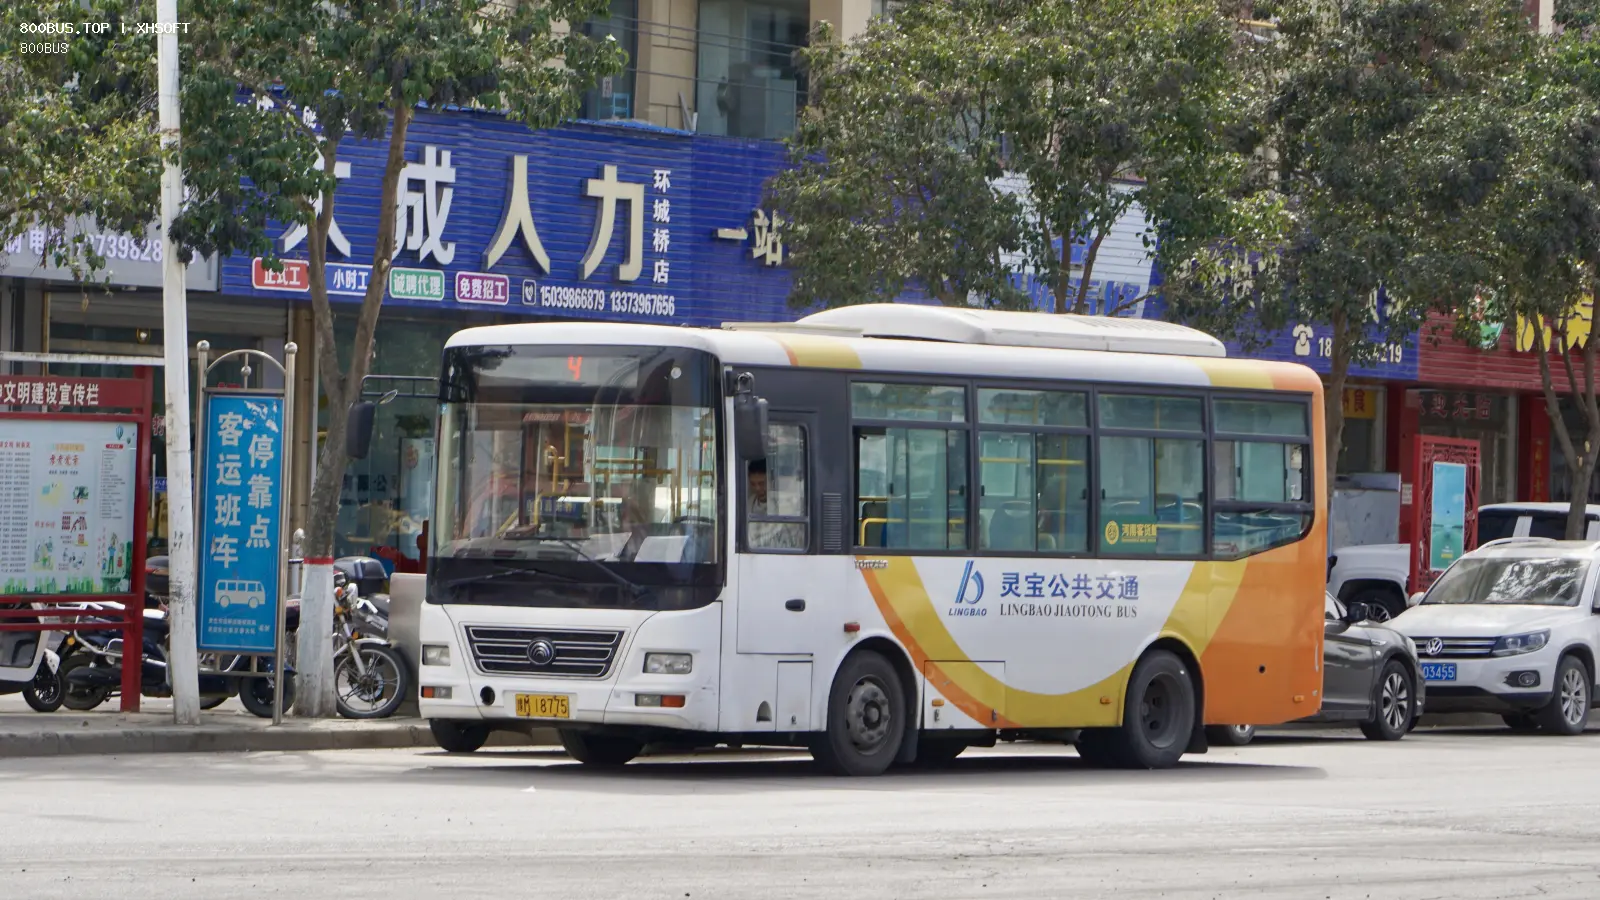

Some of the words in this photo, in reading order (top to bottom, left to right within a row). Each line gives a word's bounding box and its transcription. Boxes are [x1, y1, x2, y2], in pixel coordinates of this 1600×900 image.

[653, 169, 672, 284] 环城桥店
[332, 269, 368, 290] 小时工
[393, 273, 442, 296] 诚聘代理
[460, 278, 506, 300] 免费招工
[540, 285, 605, 311] 15039866879
[610, 291, 676, 317] 13373967656
[0, 381, 99, 405] 文明建设宣传栏
[210, 411, 244, 568] 客运班车
[245, 434, 275, 549] 停靠点
[1000, 572, 1139, 601] 灵宝公共交通
[948, 607, 988, 617] LINGBAO
[1000, 603, 1052, 617] LINGBAO
[1054, 604, 1112, 618] JIAOTONG
[1116, 606, 1138, 618] BUS
